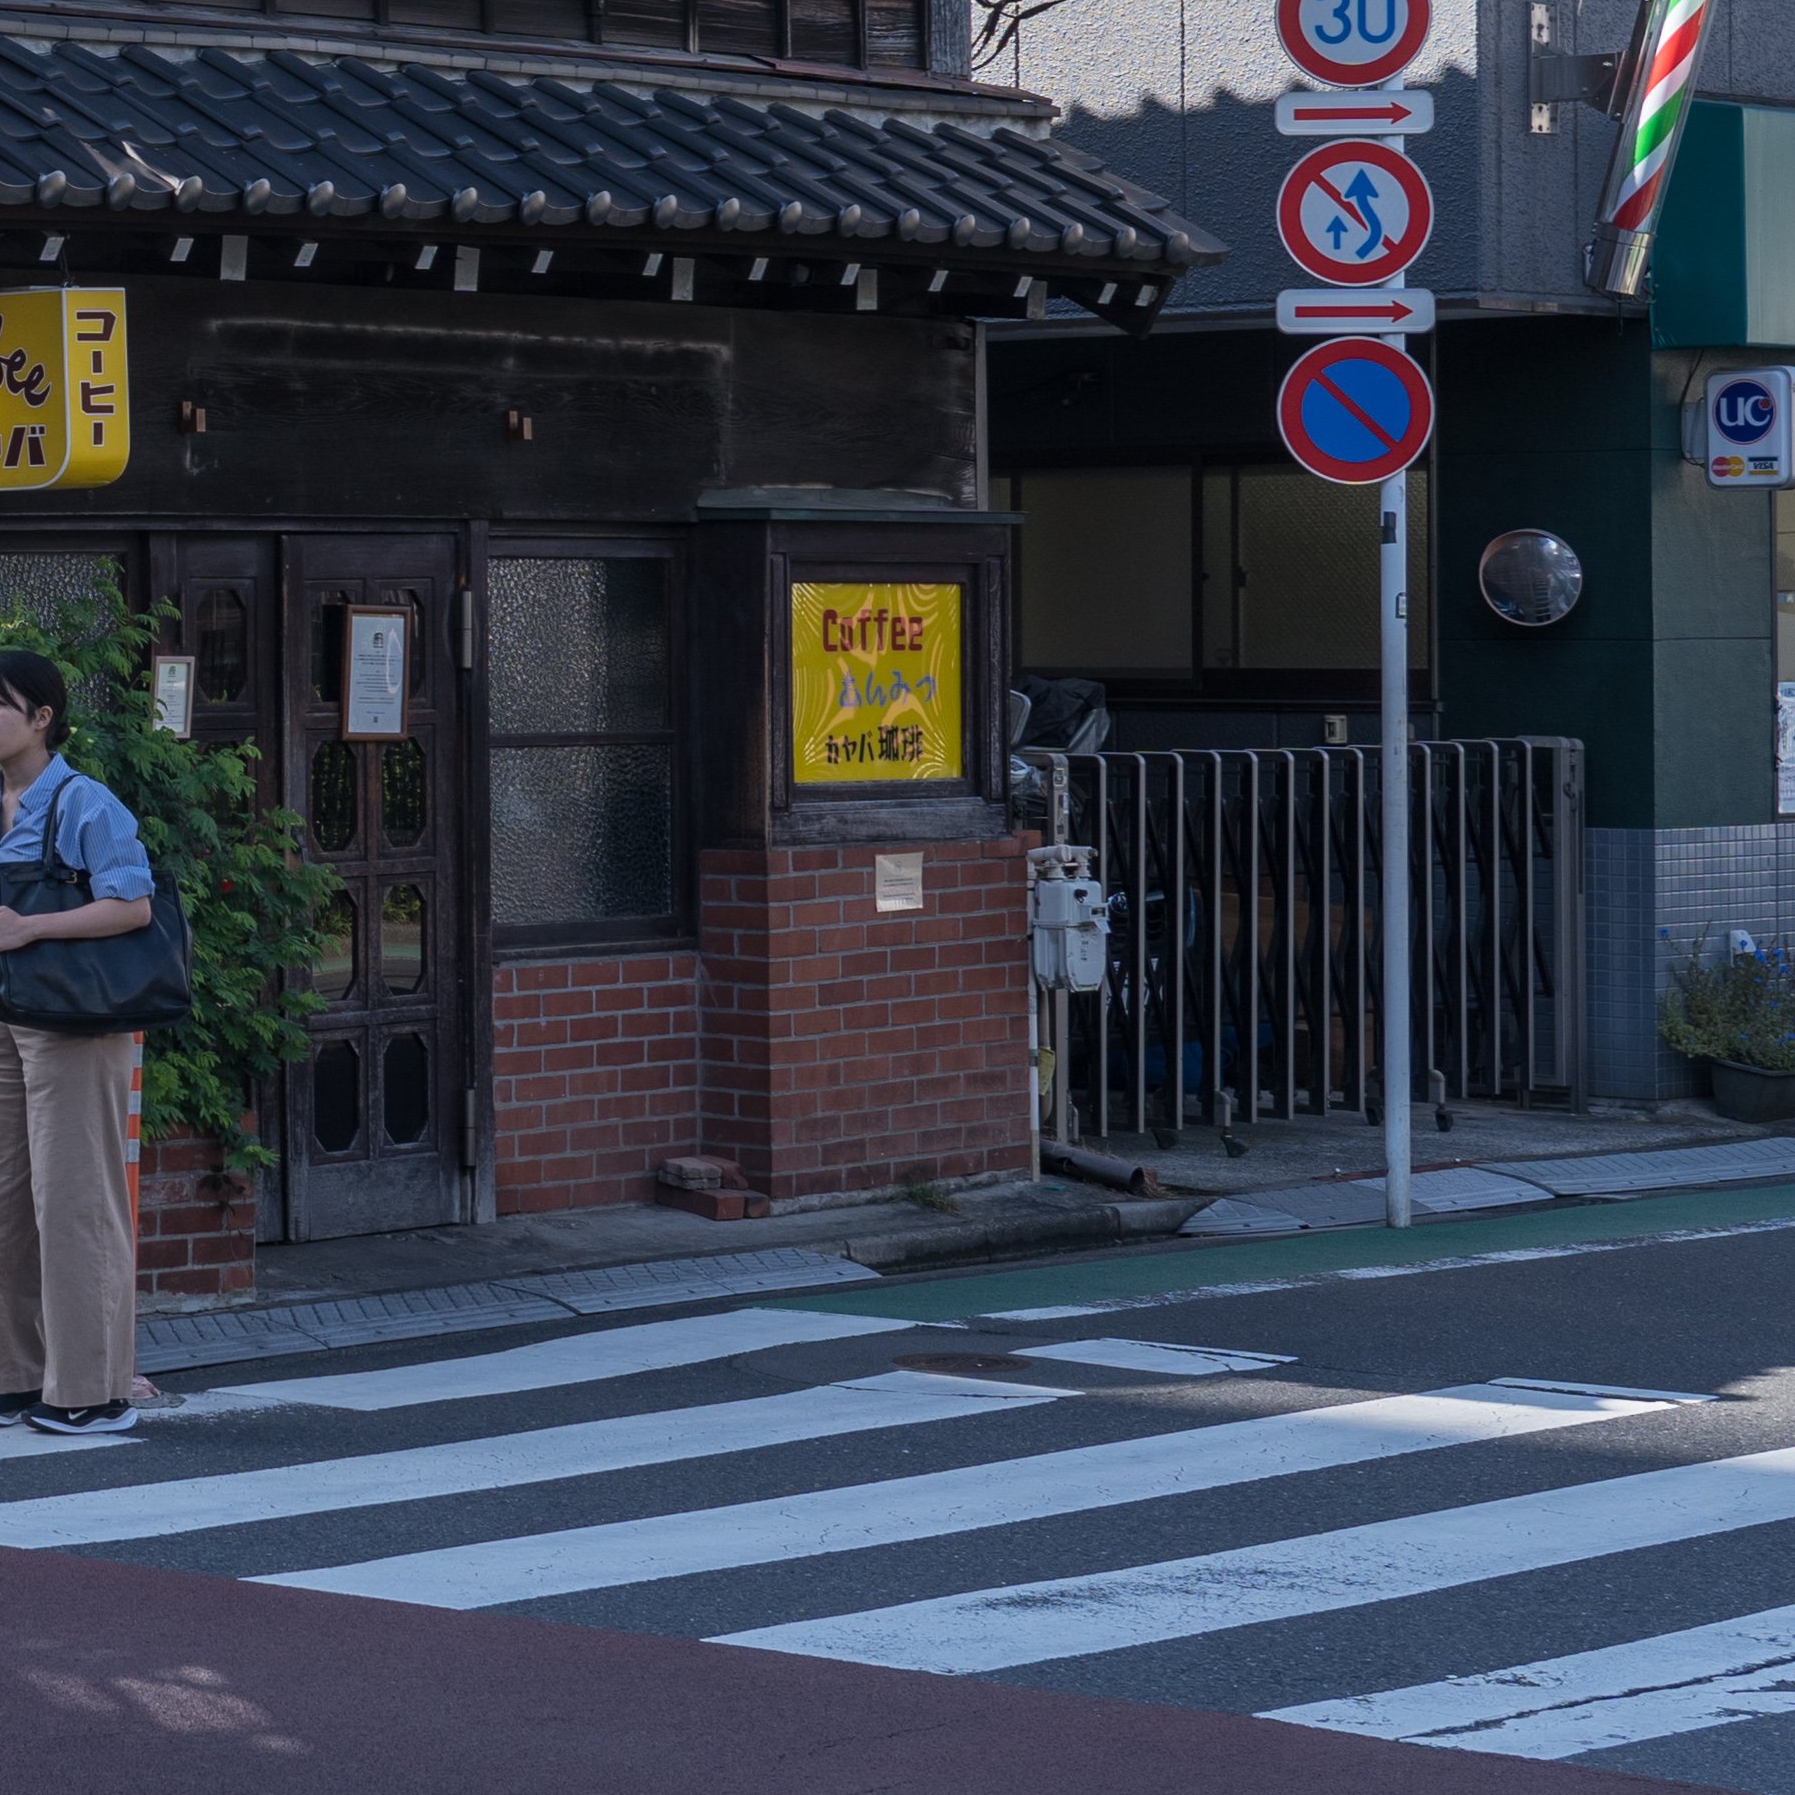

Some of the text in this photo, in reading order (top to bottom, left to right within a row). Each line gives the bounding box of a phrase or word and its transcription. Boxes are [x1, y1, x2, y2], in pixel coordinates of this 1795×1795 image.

[75, 308, 118, 448] コーヒー
[1753, 461, 1774, 470] VISA
[822, 608, 924, 653] Coffee
[839, 669, 937, 709] あんみつ
